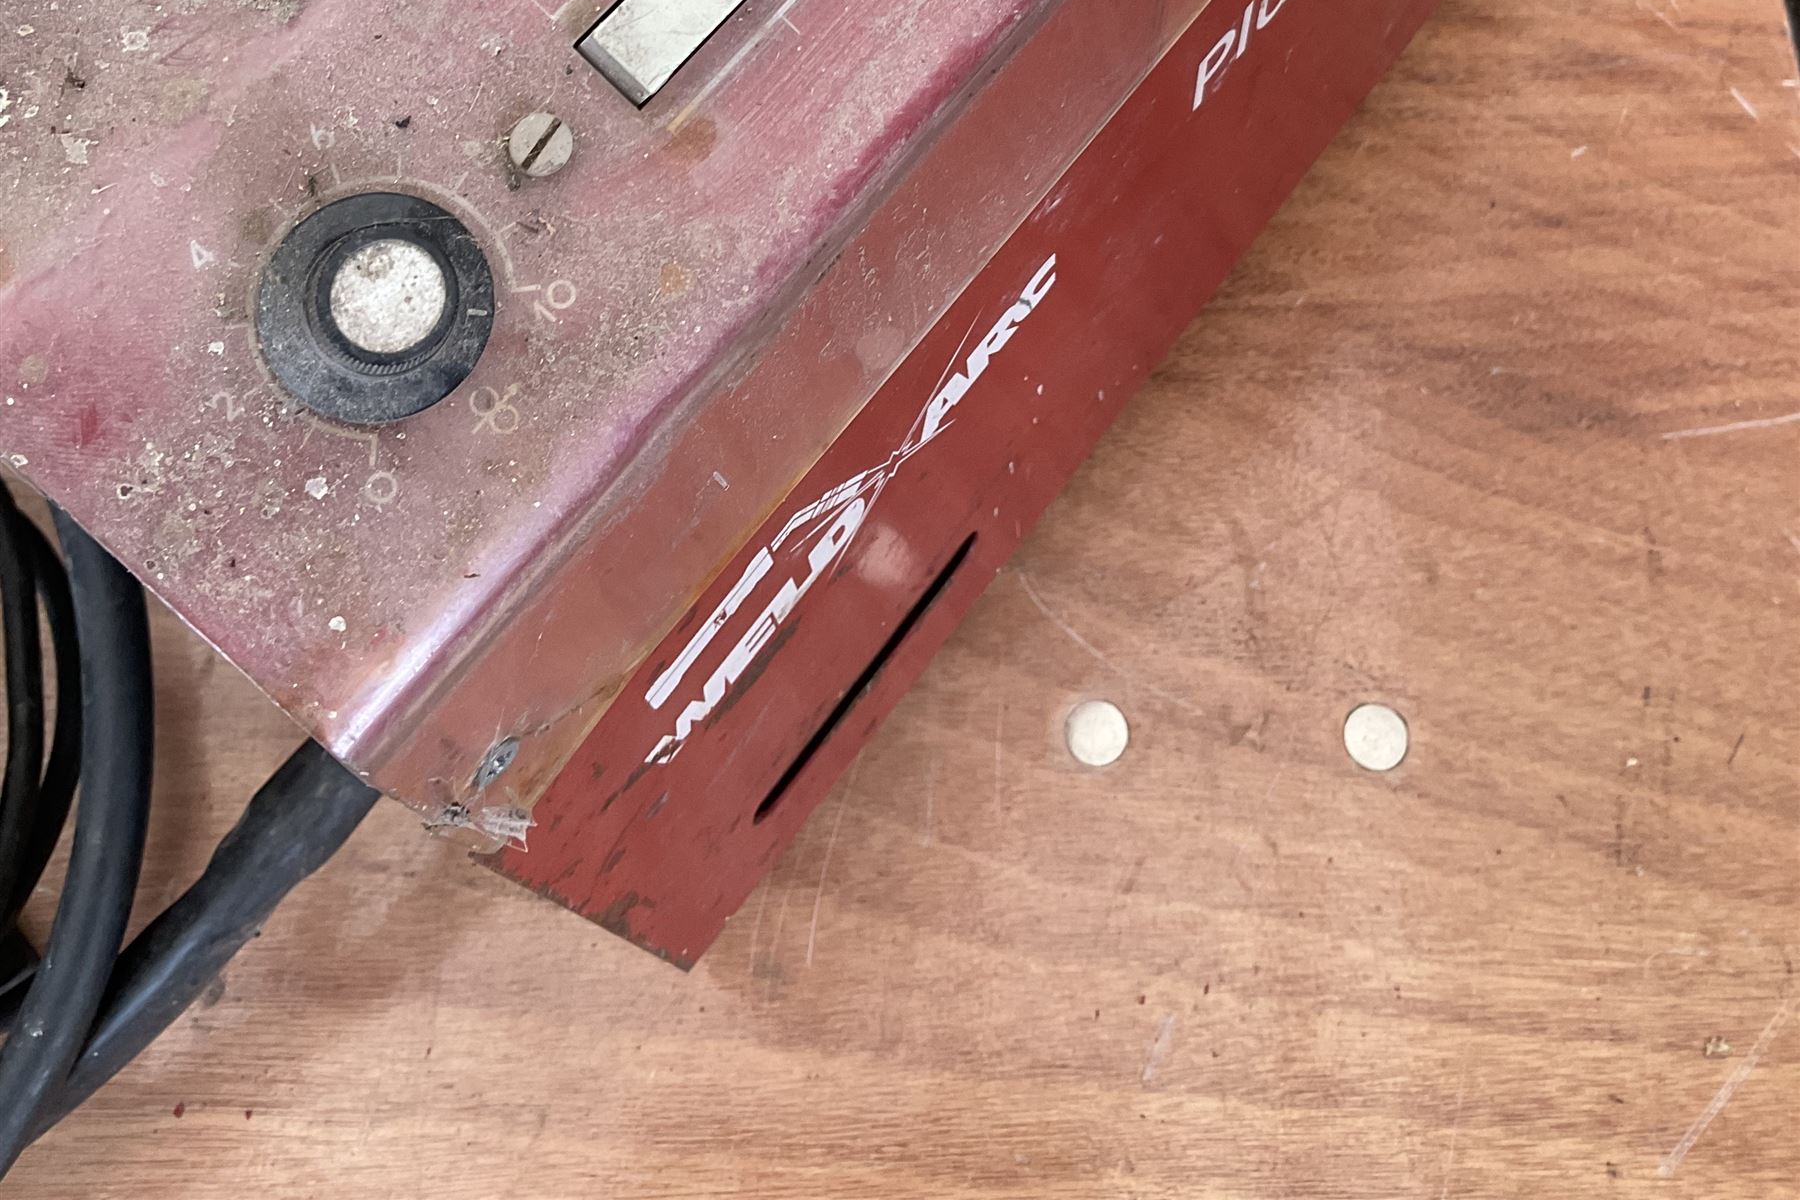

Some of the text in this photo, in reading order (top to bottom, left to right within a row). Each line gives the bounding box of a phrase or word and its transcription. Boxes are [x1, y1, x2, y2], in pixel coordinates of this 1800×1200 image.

[190, 240, 215, 271] 4
[533, 280, 577, 322] 10
[204, 391, 246, 421] 2
[365, 471, 398, 503] 0
[644, 253, 1056, 764] WELD ARC
